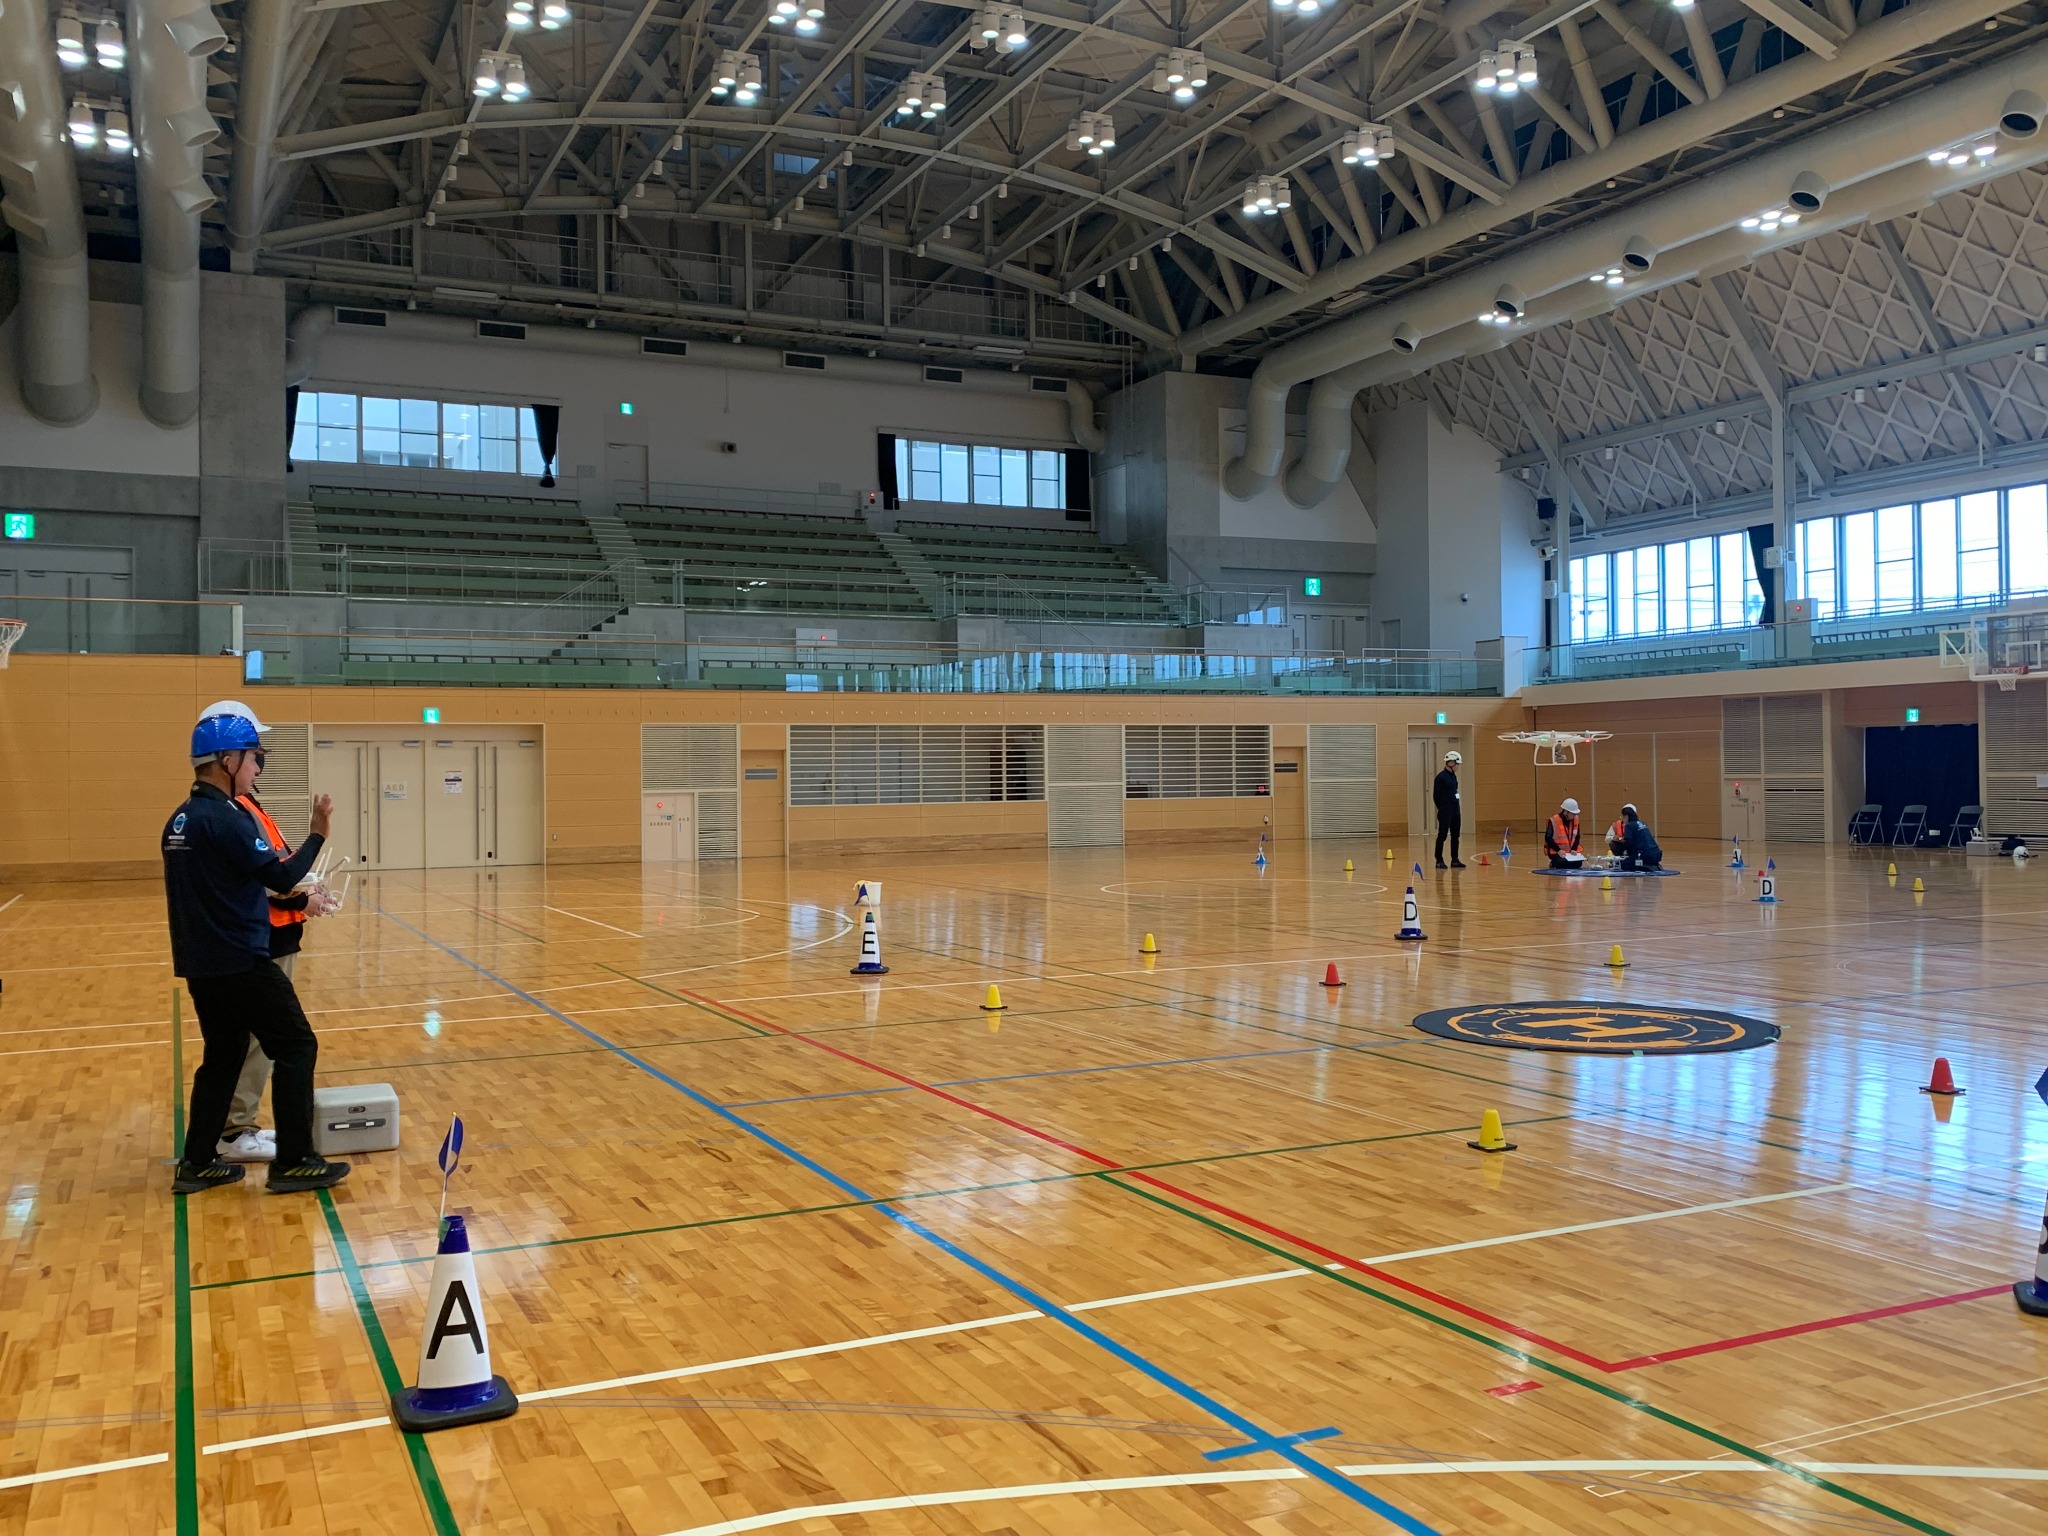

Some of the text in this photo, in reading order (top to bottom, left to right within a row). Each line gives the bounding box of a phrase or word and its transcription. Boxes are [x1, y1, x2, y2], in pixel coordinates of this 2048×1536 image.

[1762, 879, 1772, 896] D
[1404, 901, 1418, 921] D
[861, 931, 876, 955] E
[425, 1280, 485, 1360] A
